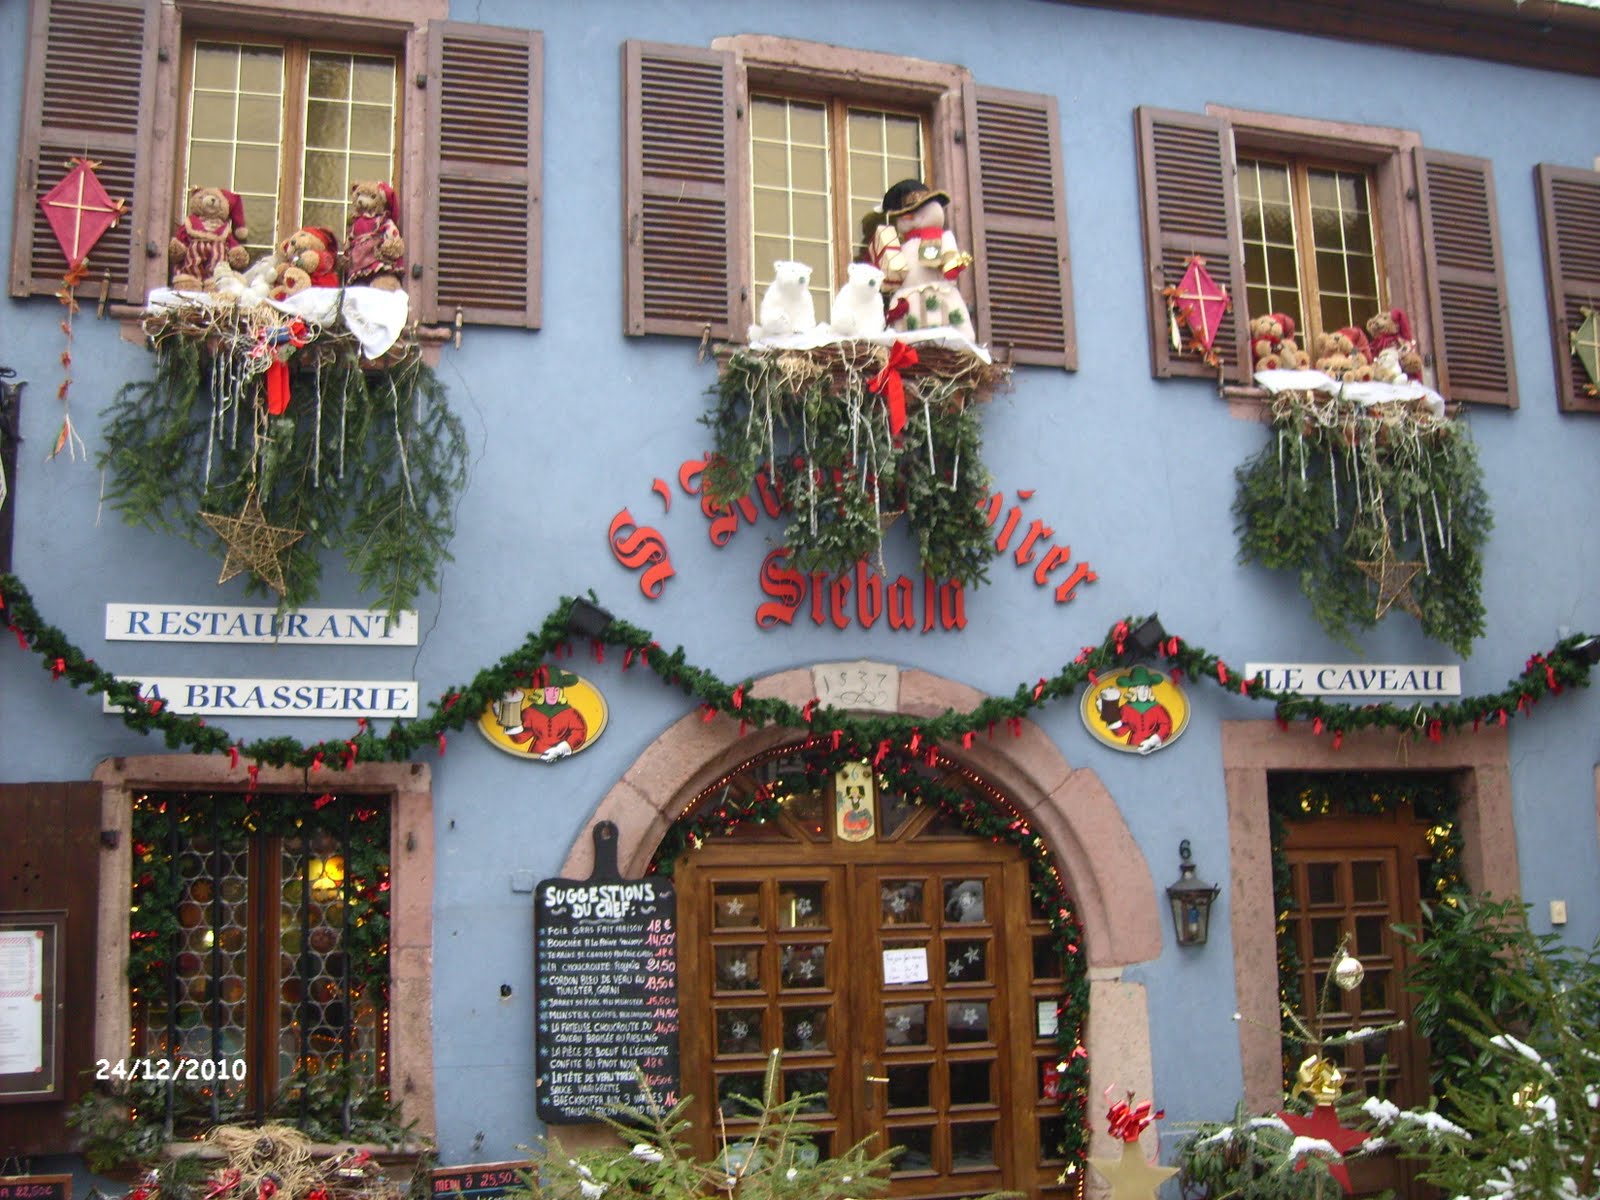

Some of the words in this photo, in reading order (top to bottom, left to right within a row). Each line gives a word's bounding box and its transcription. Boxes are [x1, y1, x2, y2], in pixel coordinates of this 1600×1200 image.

[126, 610, 403, 640] RESTAURANT
[1260, 668, 1304, 690] LE
[1316, 668, 1449, 691] CAVEAU
[183, 684, 411, 711] BRASSERIE
[1179, 839, 1192, 860] 6
[545, 883, 656, 906] SUGGESTIONS
[571, 903, 592, 918] DU
